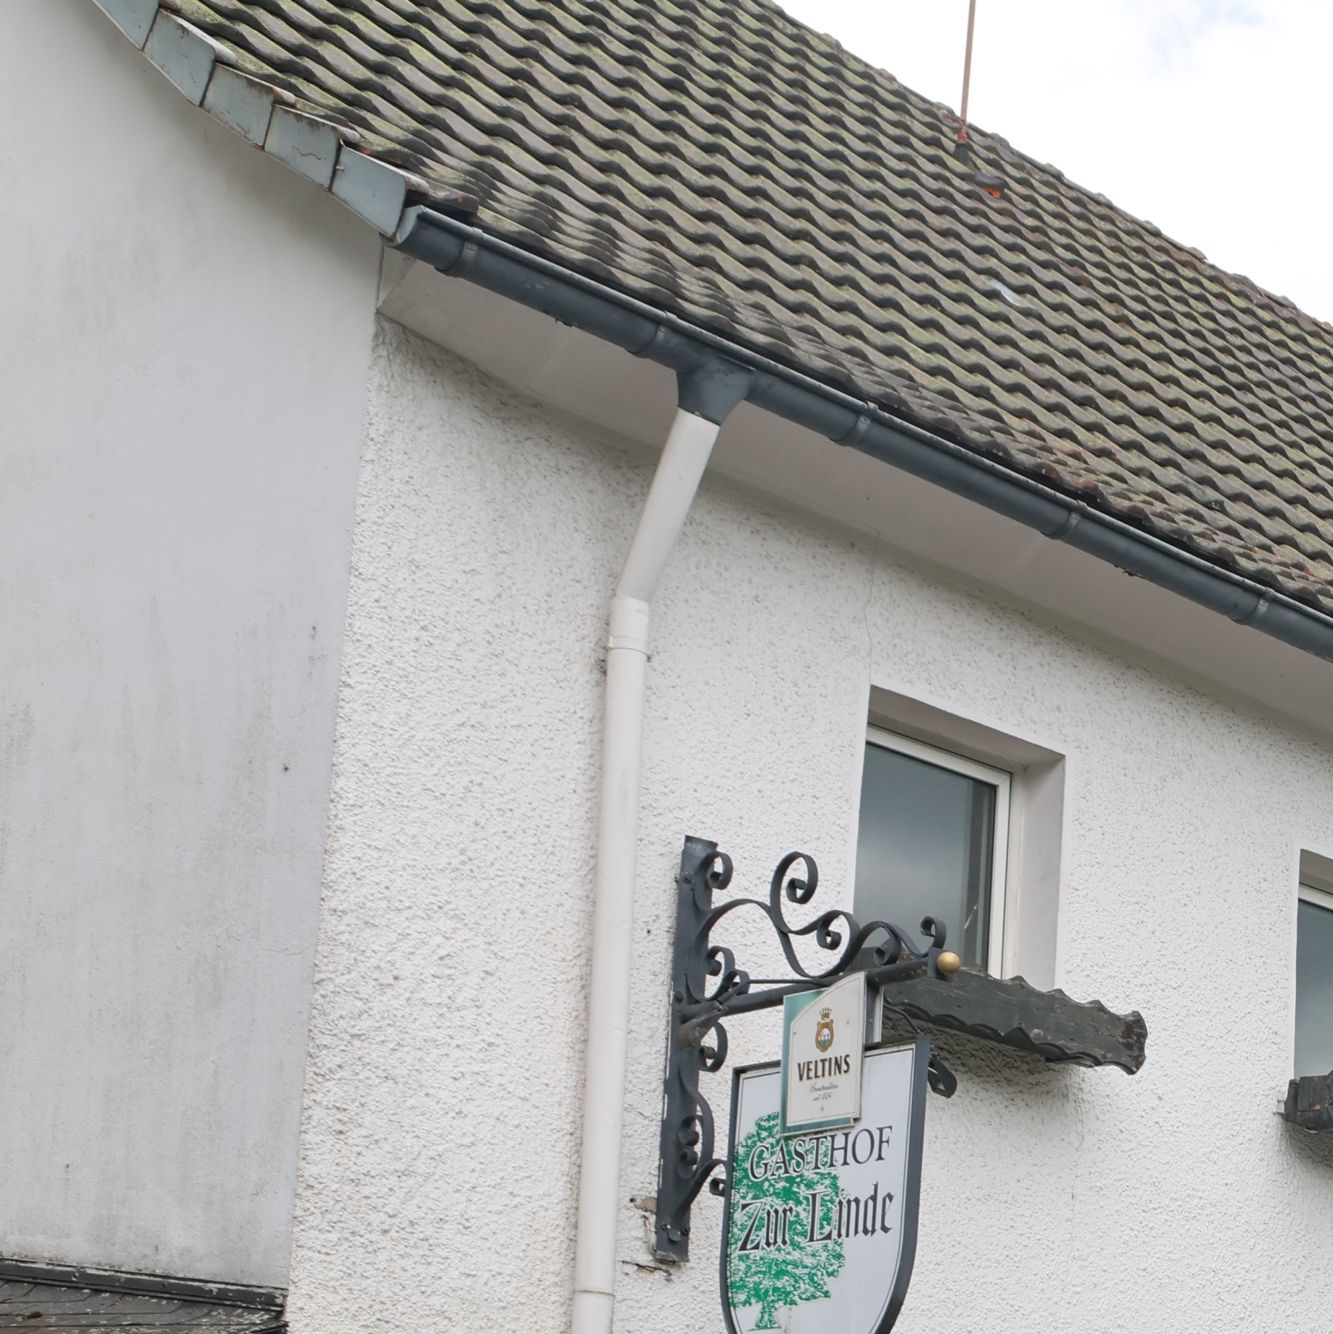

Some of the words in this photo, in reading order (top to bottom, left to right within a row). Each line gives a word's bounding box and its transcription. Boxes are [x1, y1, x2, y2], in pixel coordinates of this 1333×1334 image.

[797, 1054, 850, 1081] VELTINS
[750, 1126, 892, 1180] GASTHOF
[739, 1201, 793, 1251] Zur
[804, 1182, 895, 1243] Linde
